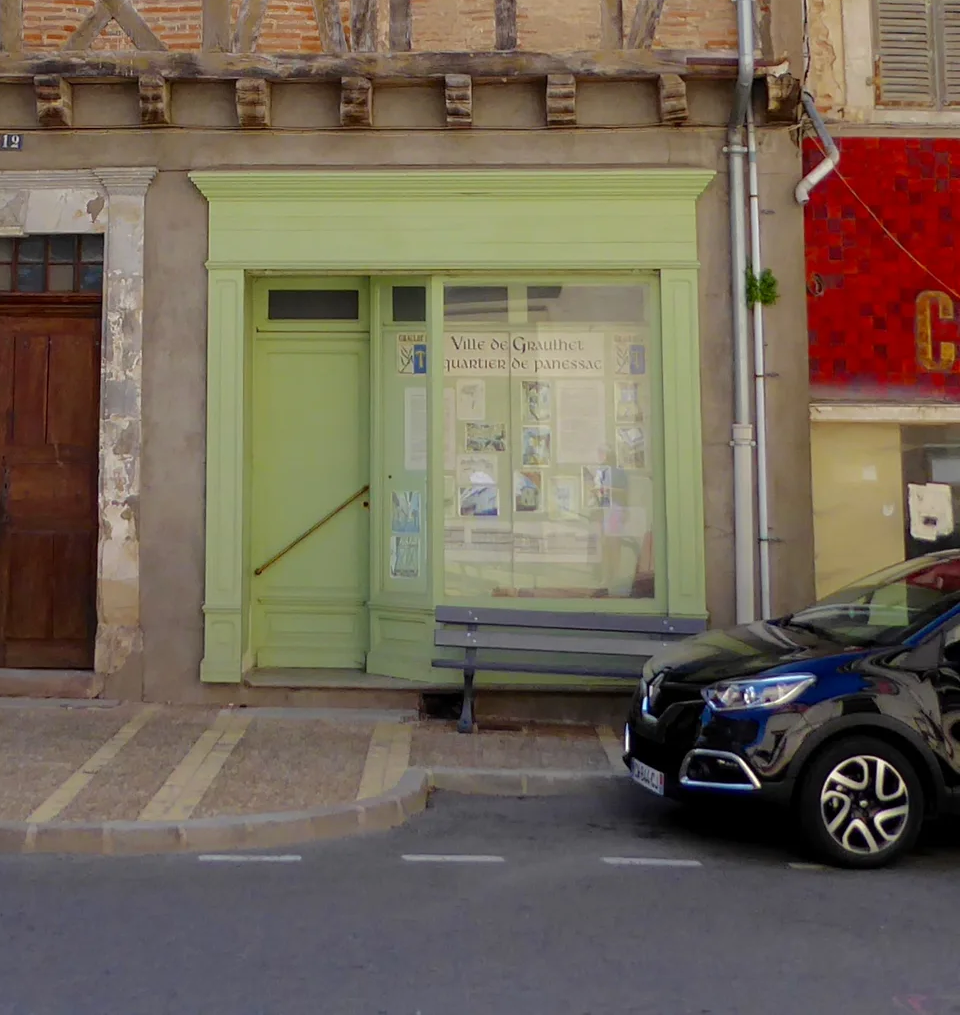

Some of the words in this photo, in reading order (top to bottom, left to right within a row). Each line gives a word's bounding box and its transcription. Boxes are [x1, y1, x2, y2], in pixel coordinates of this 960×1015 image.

[450, 335, 486, 351] Ville
[490, 337, 509, 351] de
[511, 357, 529, 370] de
[534, 358, 603, 373] panessac
